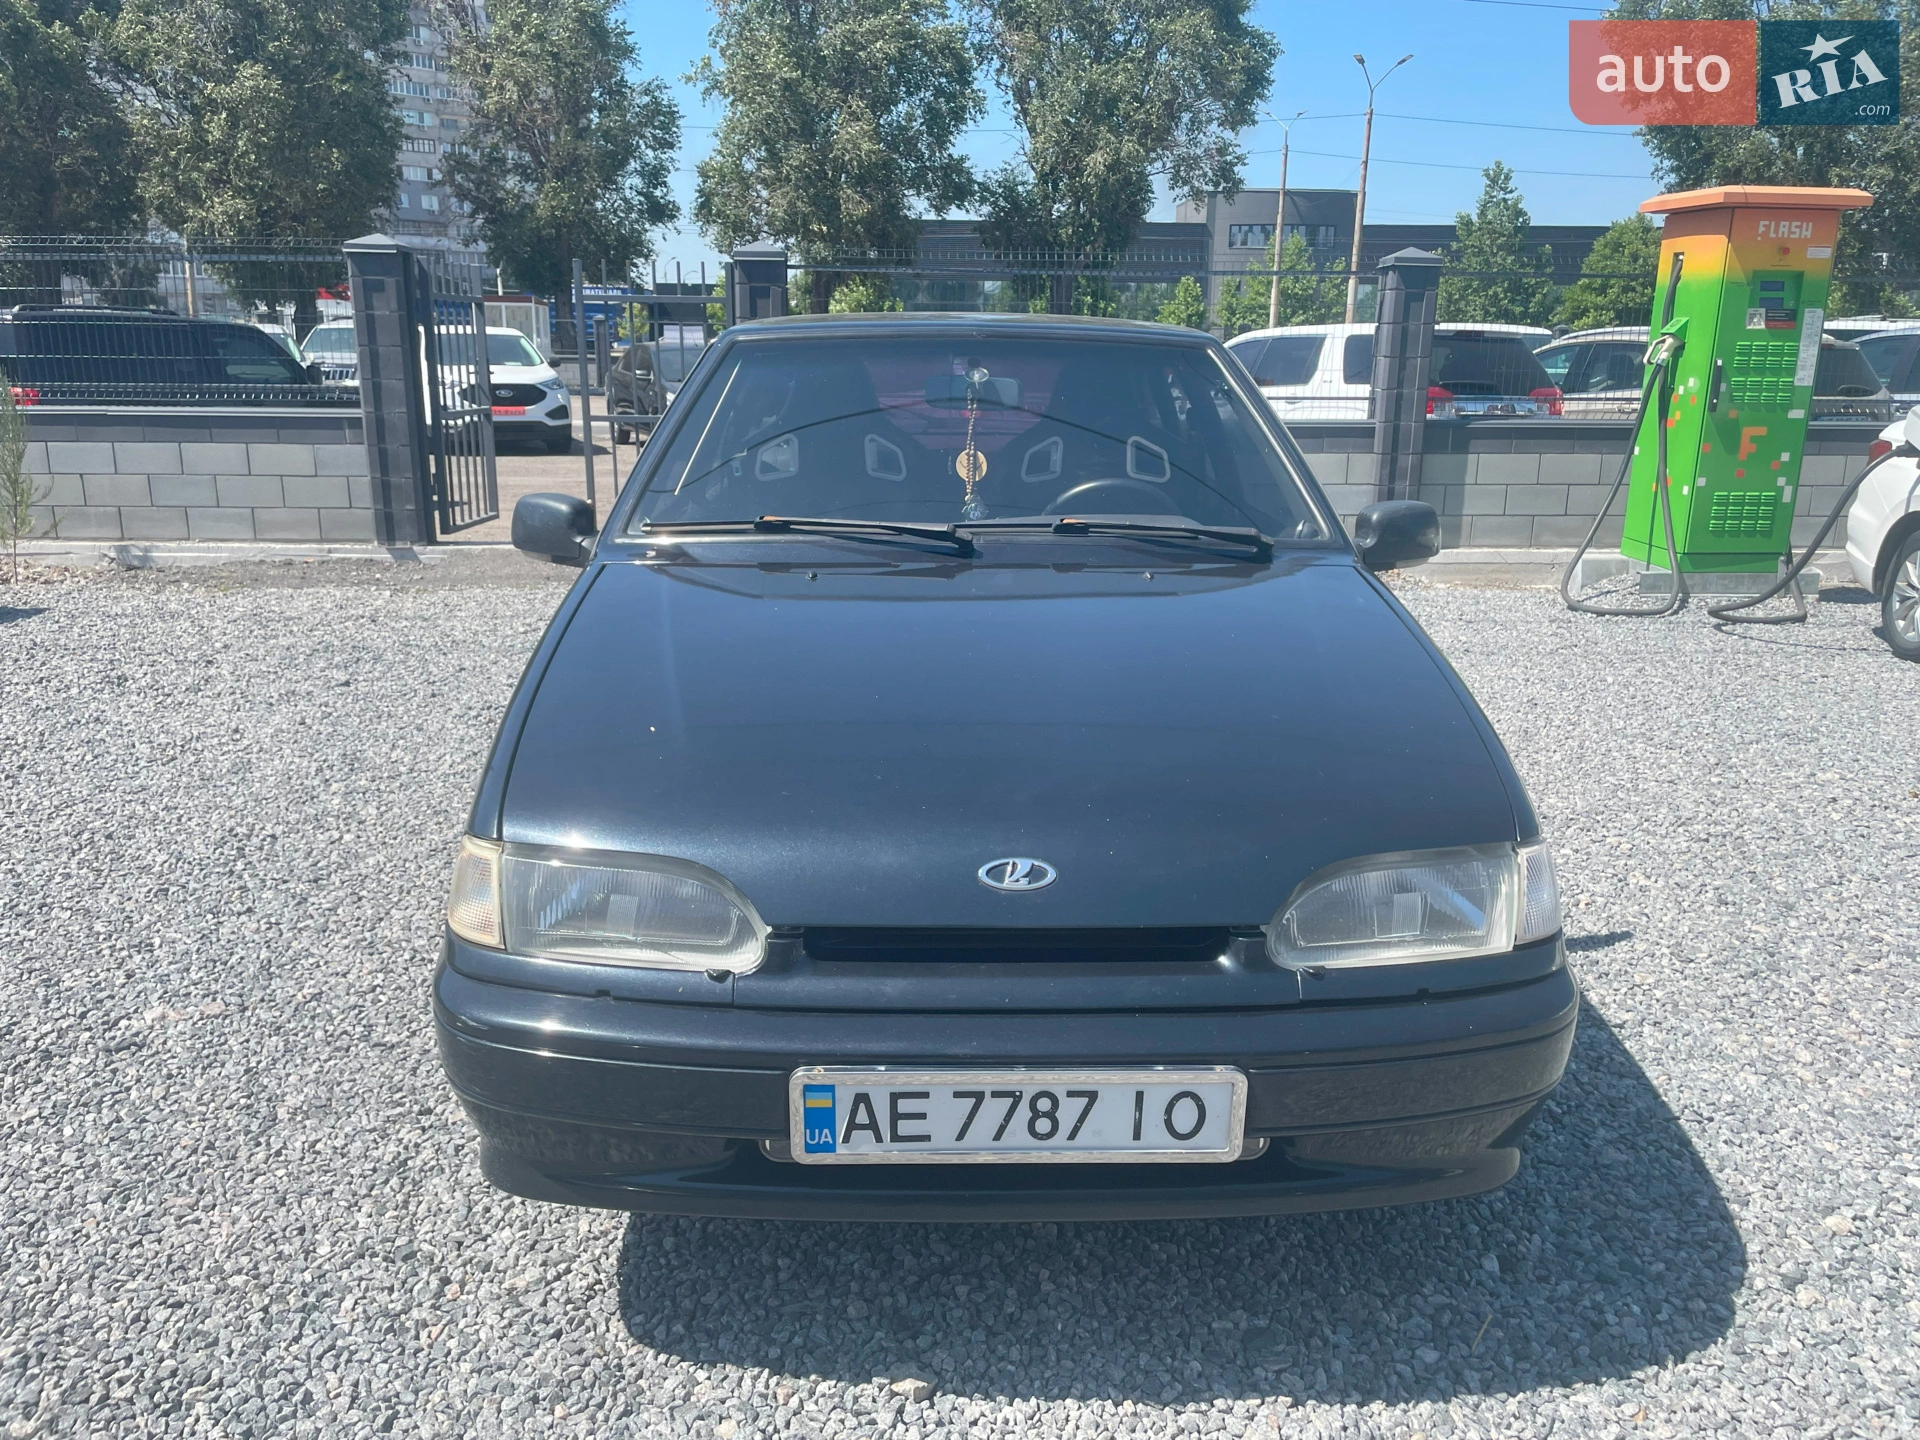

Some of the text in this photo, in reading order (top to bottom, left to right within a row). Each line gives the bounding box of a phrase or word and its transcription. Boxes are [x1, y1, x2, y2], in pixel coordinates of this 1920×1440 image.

[1757, 220, 1813, 240] FLASH
[840, 1090, 1207, 1144] AE 7787 IO
[804, 1128, 834, 1145] UA
